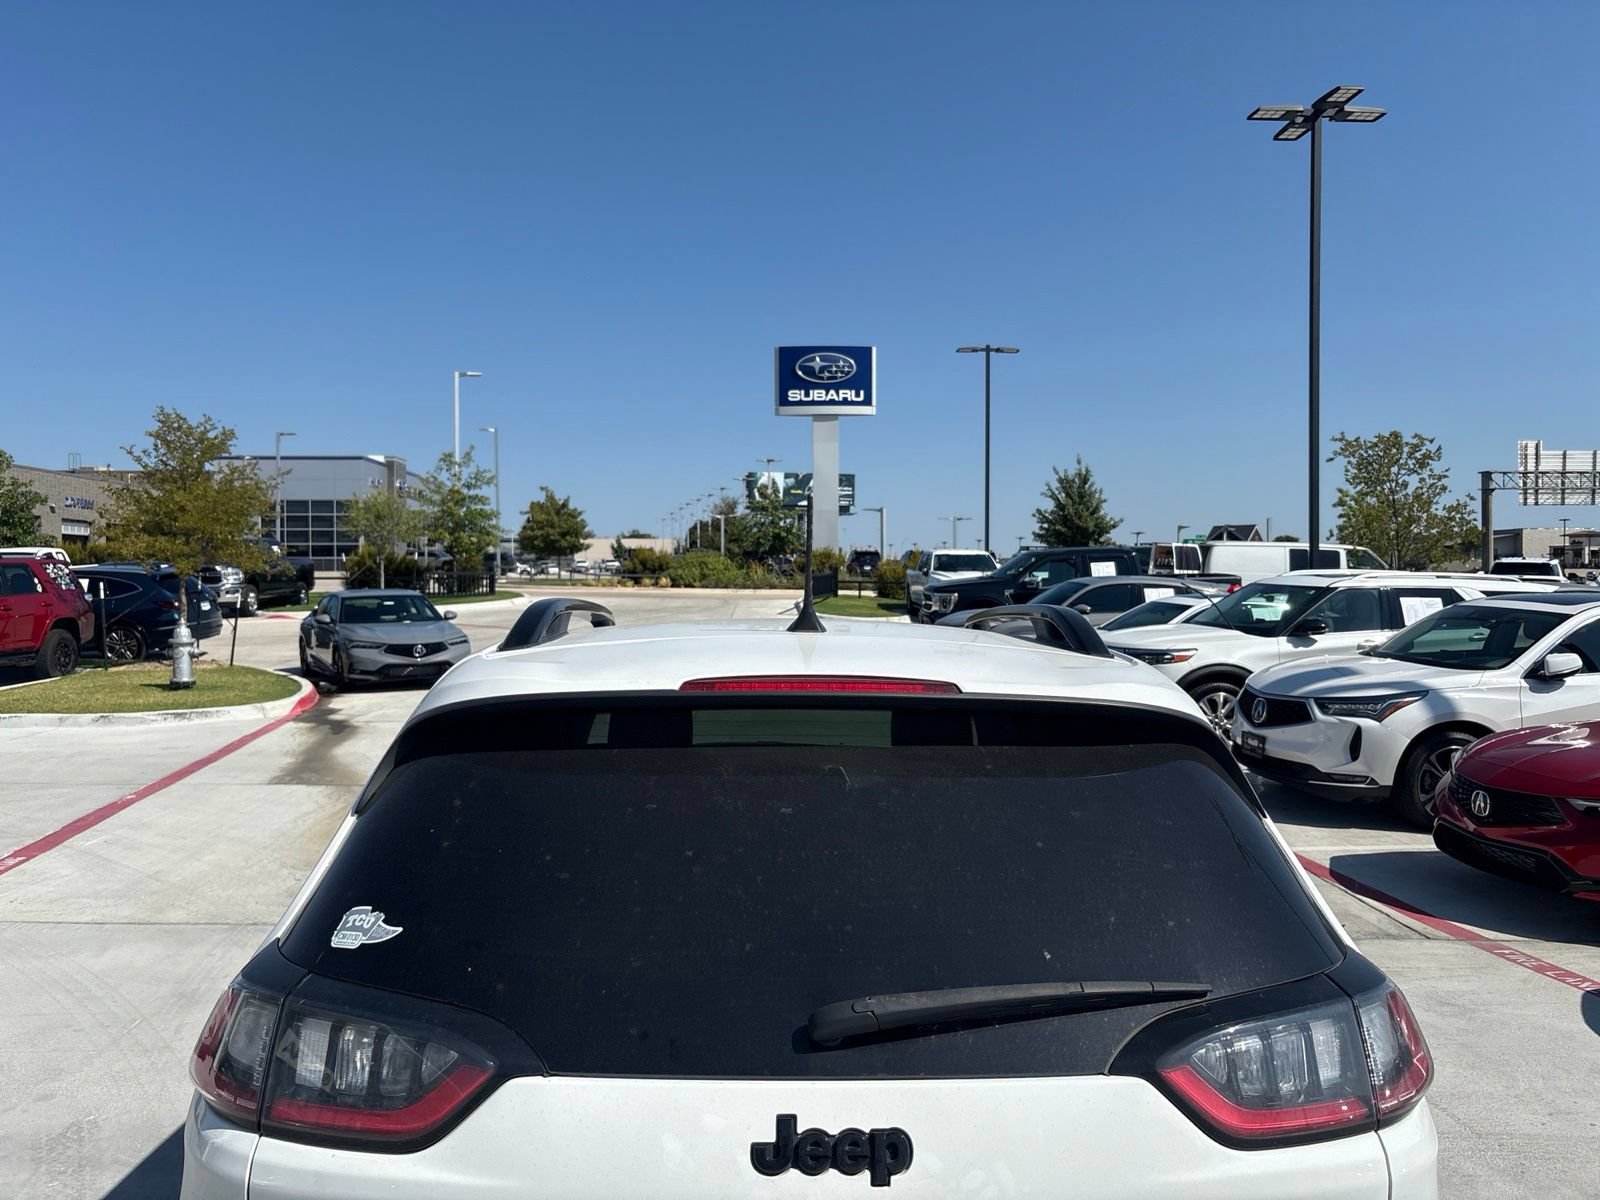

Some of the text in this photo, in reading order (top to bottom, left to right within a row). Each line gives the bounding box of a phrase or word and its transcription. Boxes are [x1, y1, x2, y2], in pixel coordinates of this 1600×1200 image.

[787, 389, 864, 401] SUBARU
[1493, 949, 1550, 968] FIRE
[751, 1114, 913, 1186] Jeep
